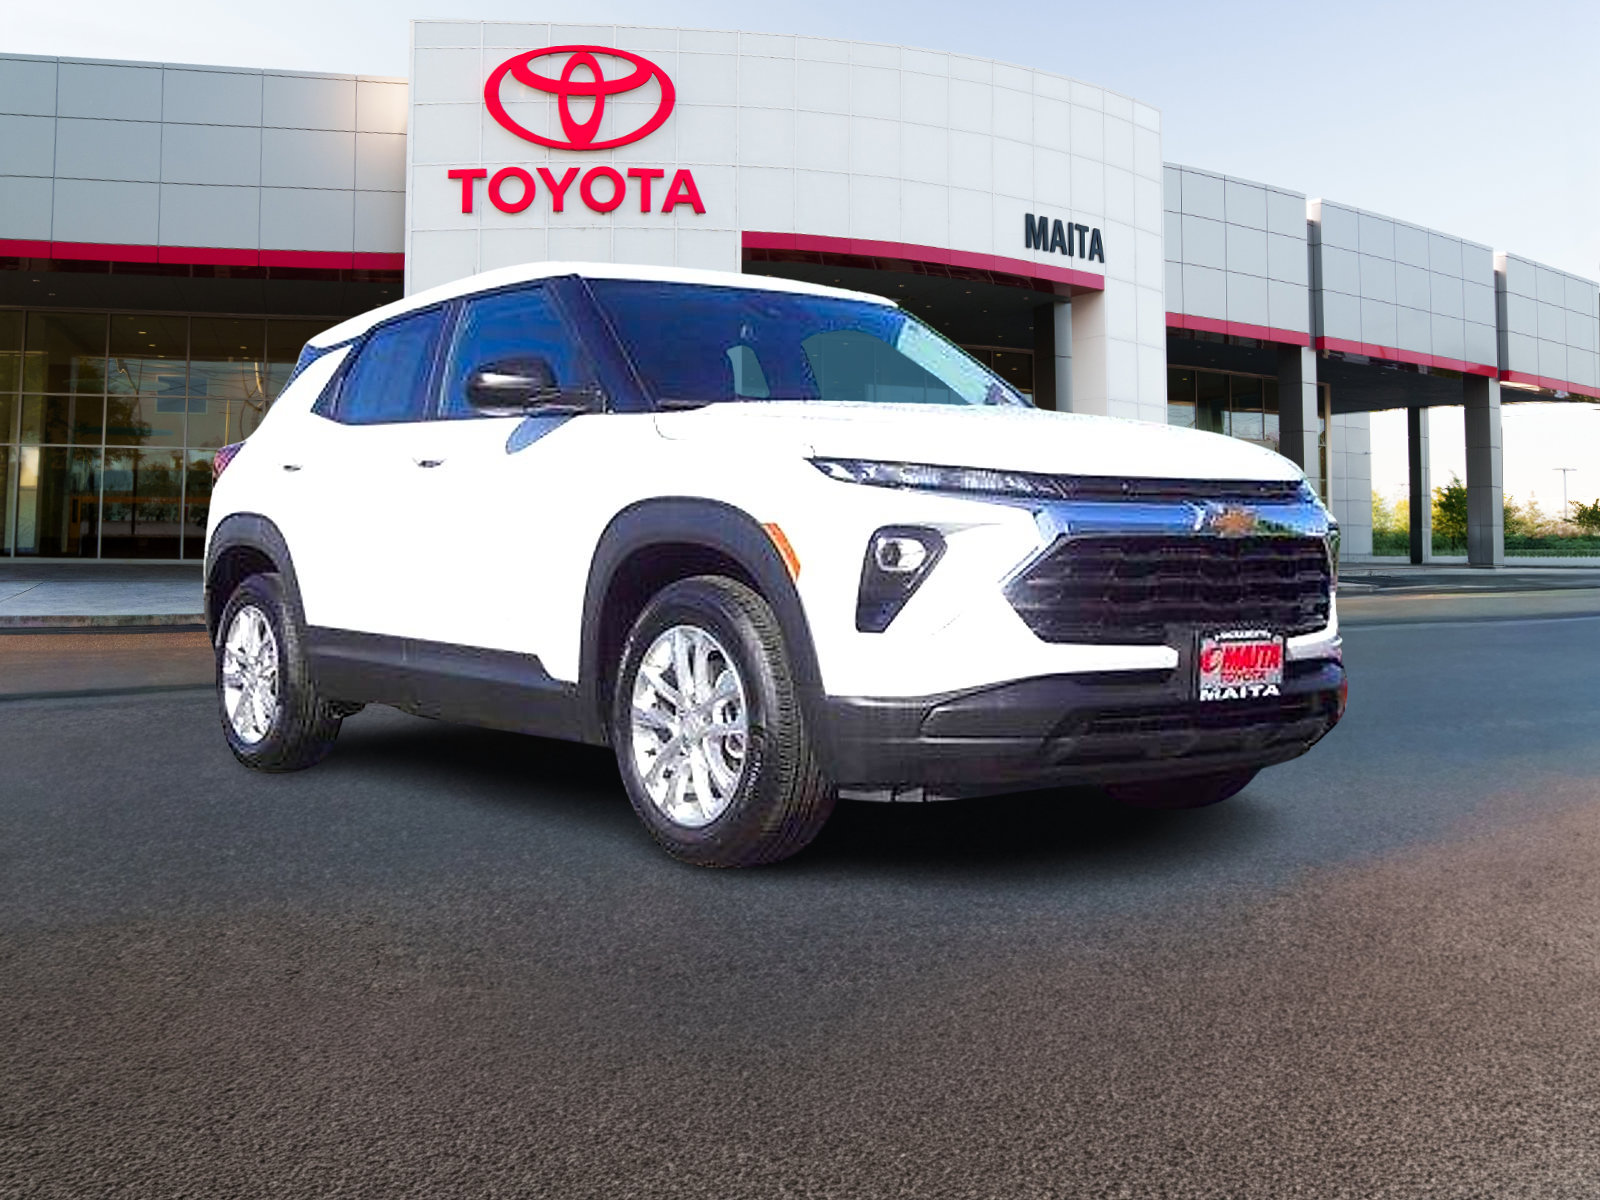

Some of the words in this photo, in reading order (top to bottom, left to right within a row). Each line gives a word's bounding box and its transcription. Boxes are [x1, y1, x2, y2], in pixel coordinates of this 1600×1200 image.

[448, 166, 706, 214] TOYOTA
[1025, 213, 1105, 263] MAITA
[1200, 684, 1281, 701] MAITA
